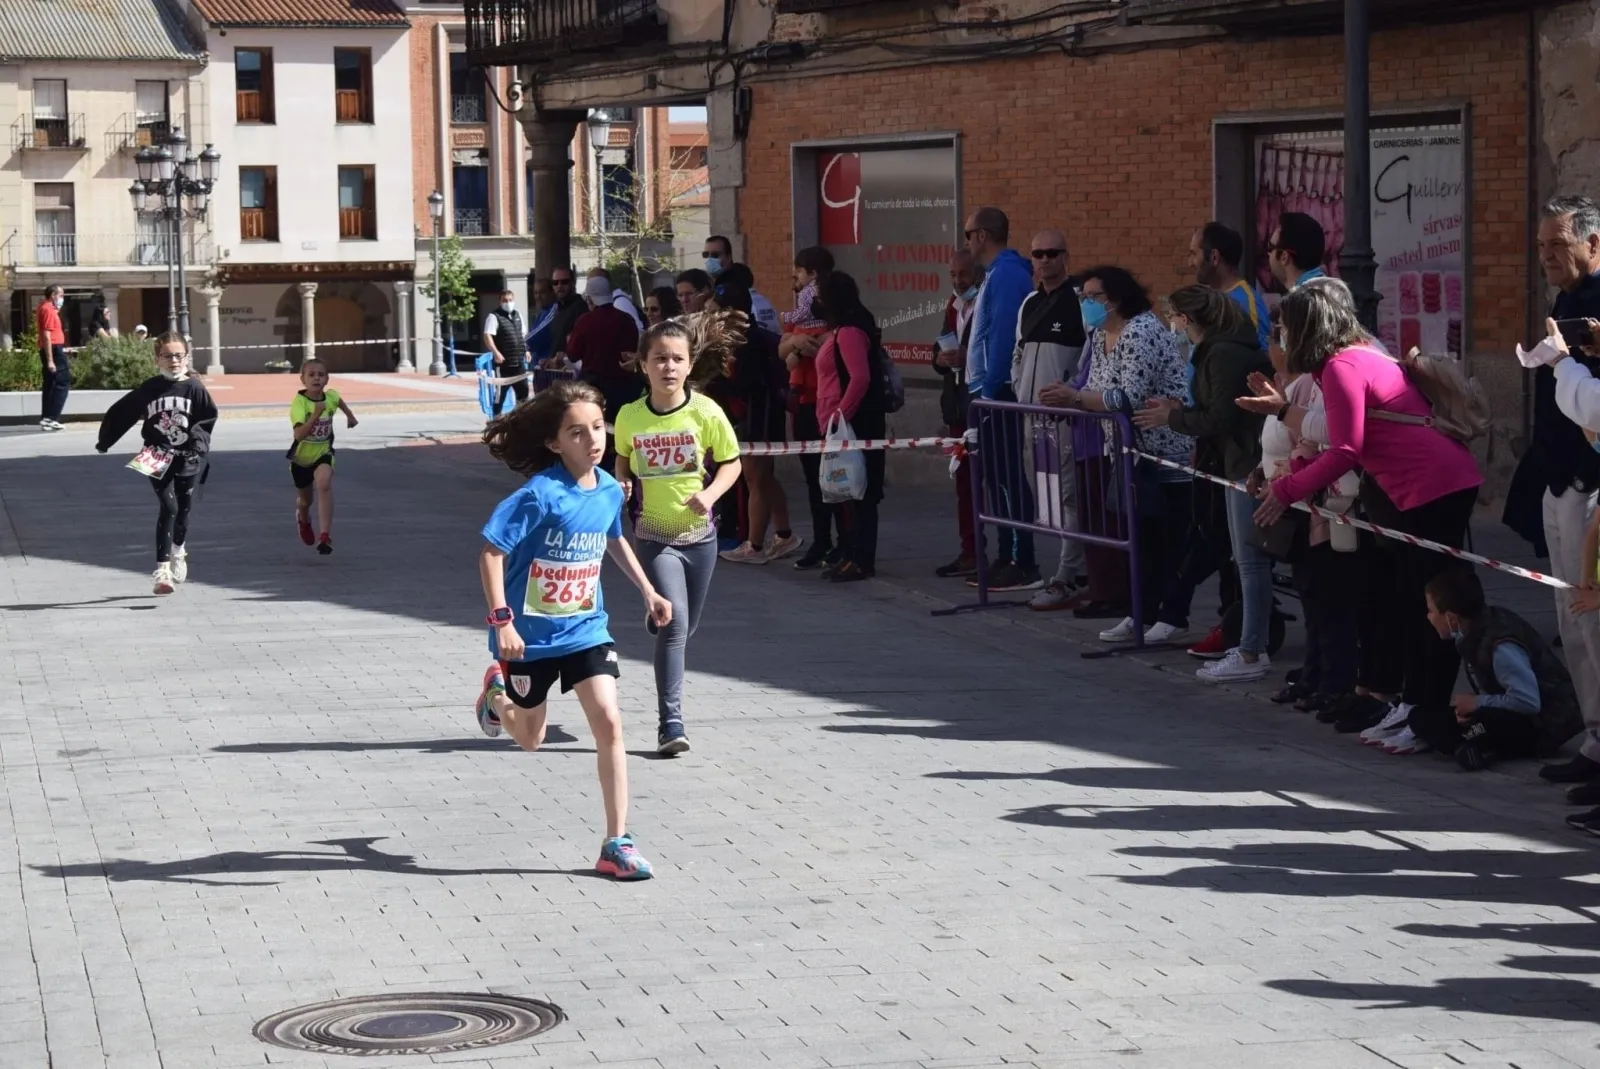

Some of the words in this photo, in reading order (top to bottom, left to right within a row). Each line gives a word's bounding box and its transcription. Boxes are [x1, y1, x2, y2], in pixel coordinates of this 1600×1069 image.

[889, 303, 925, 327] calidad
[925, 301, 937, 315] de
[633, 432, 695, 450] bedunia
[646, 447, 685, 468] 276
[544, 528, 564, 549] LA
[548, 549, 572, 560] CLUB
[530, 561, 599, 581] bedunia
[541, 580, 587, 604] 263
